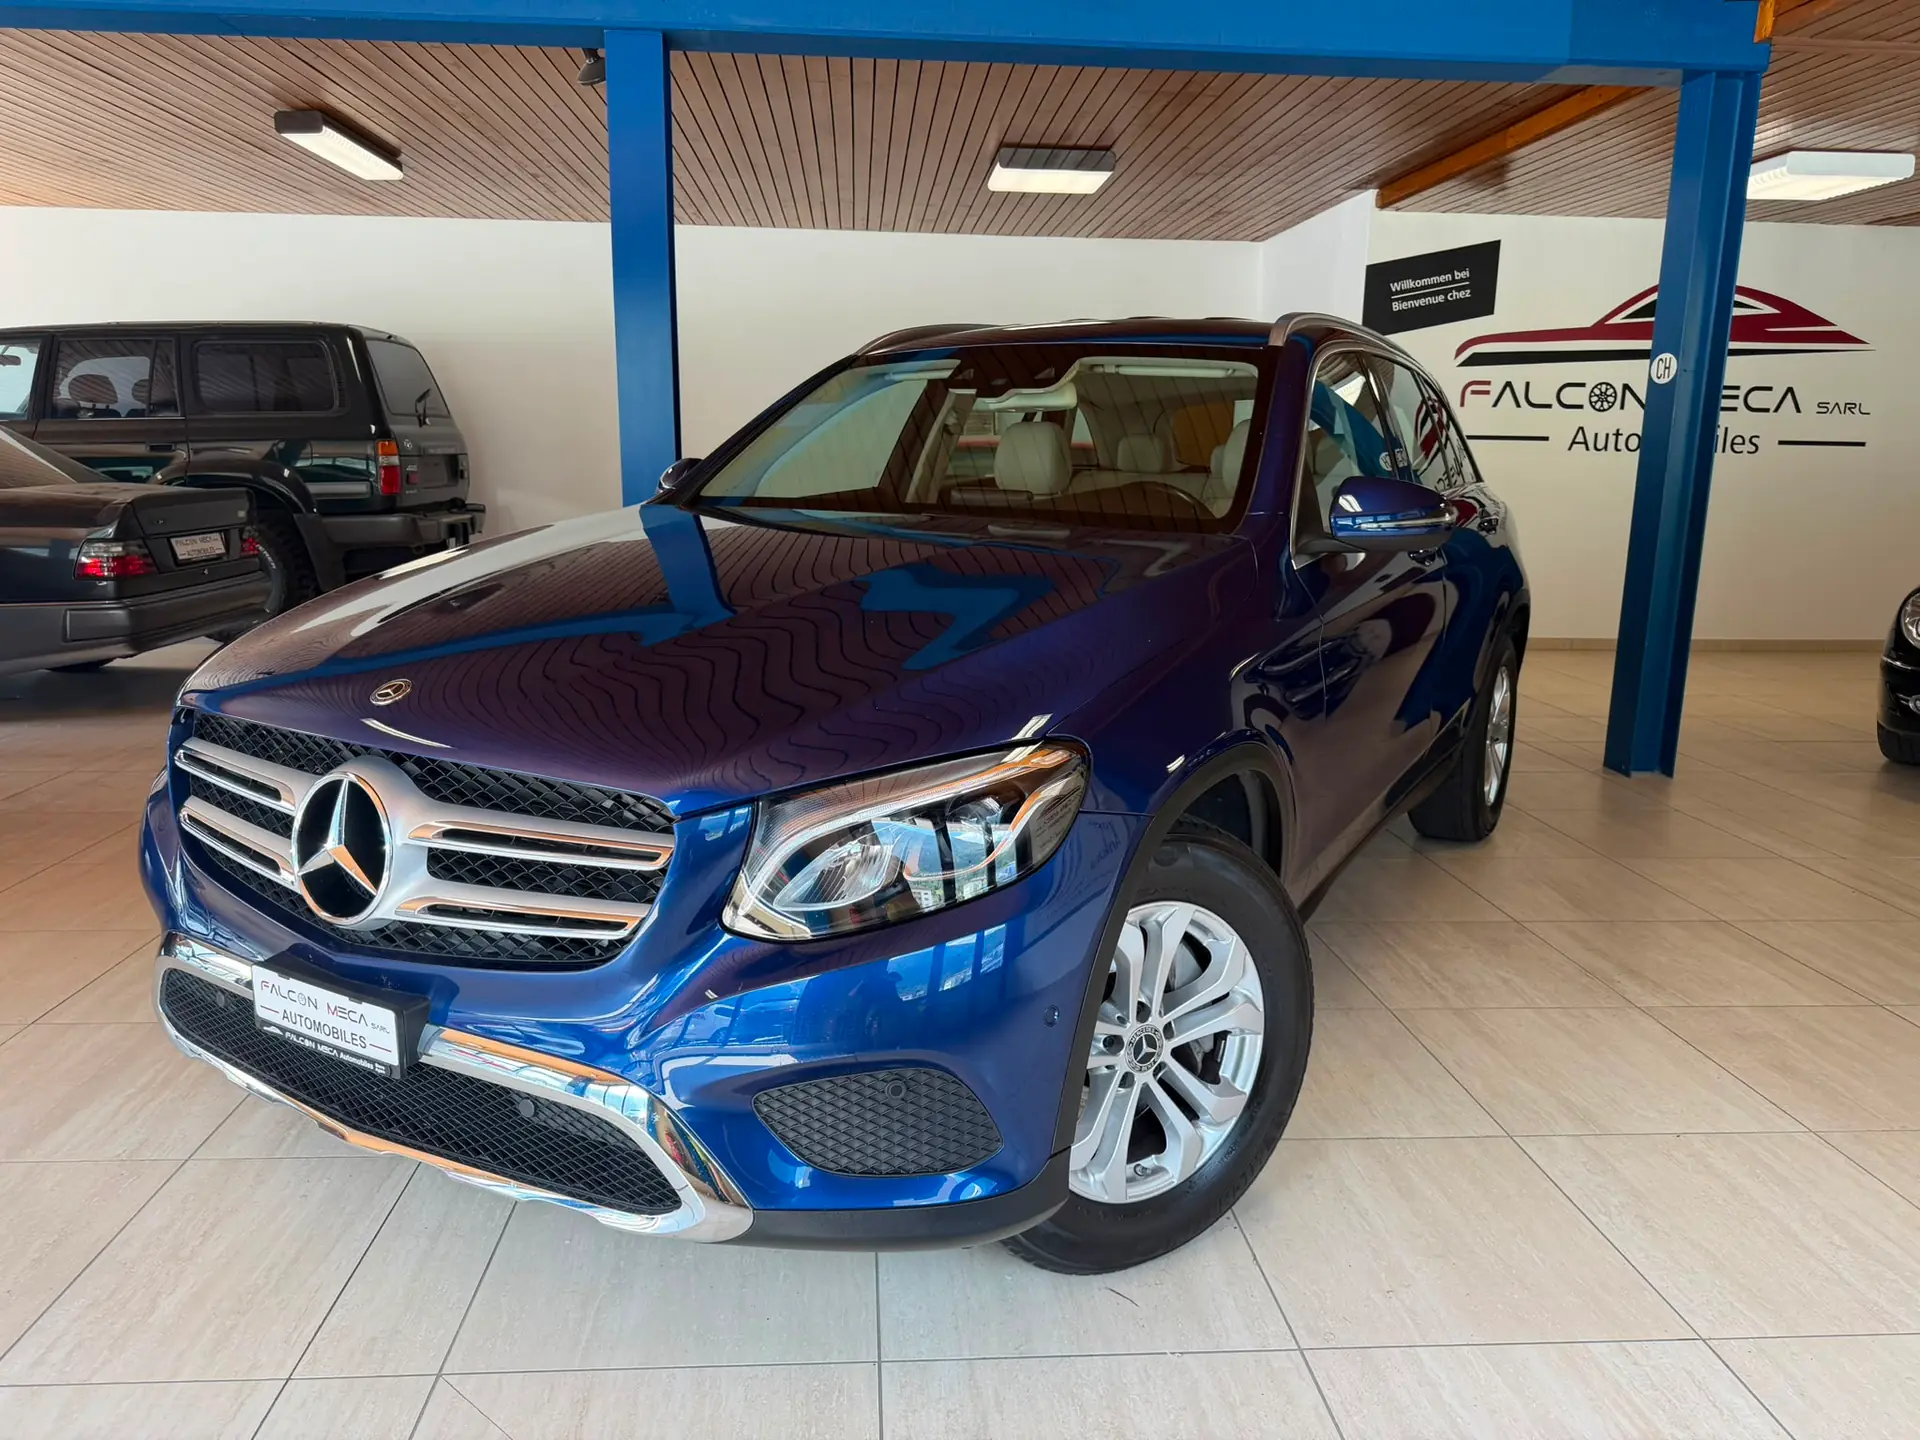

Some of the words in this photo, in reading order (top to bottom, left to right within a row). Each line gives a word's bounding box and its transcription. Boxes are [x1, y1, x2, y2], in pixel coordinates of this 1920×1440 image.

[1389, 272, 1452, 292] Willkommen
[1454, 267, 1470, 280] bei
[1391, 293, 1445, 312] Bienvenue
[1447, 288, 1471, 301] chez
[1656, 356, 1673, 380] CH
[1720, 385, 1802, 414] ECA
[1816, 401, 1871, 416] SARL
[260, 980, 318, 1010] FALCON
[326, 1002, 368, 1027] MECA
[282, 1009, 367, 1049] AUTOMOBILES
[285, 1031, 316, 1049] FALCON
[317, 1043, 339, 1058] MECA
[339, 1052, 374, 1069] Automobiles
